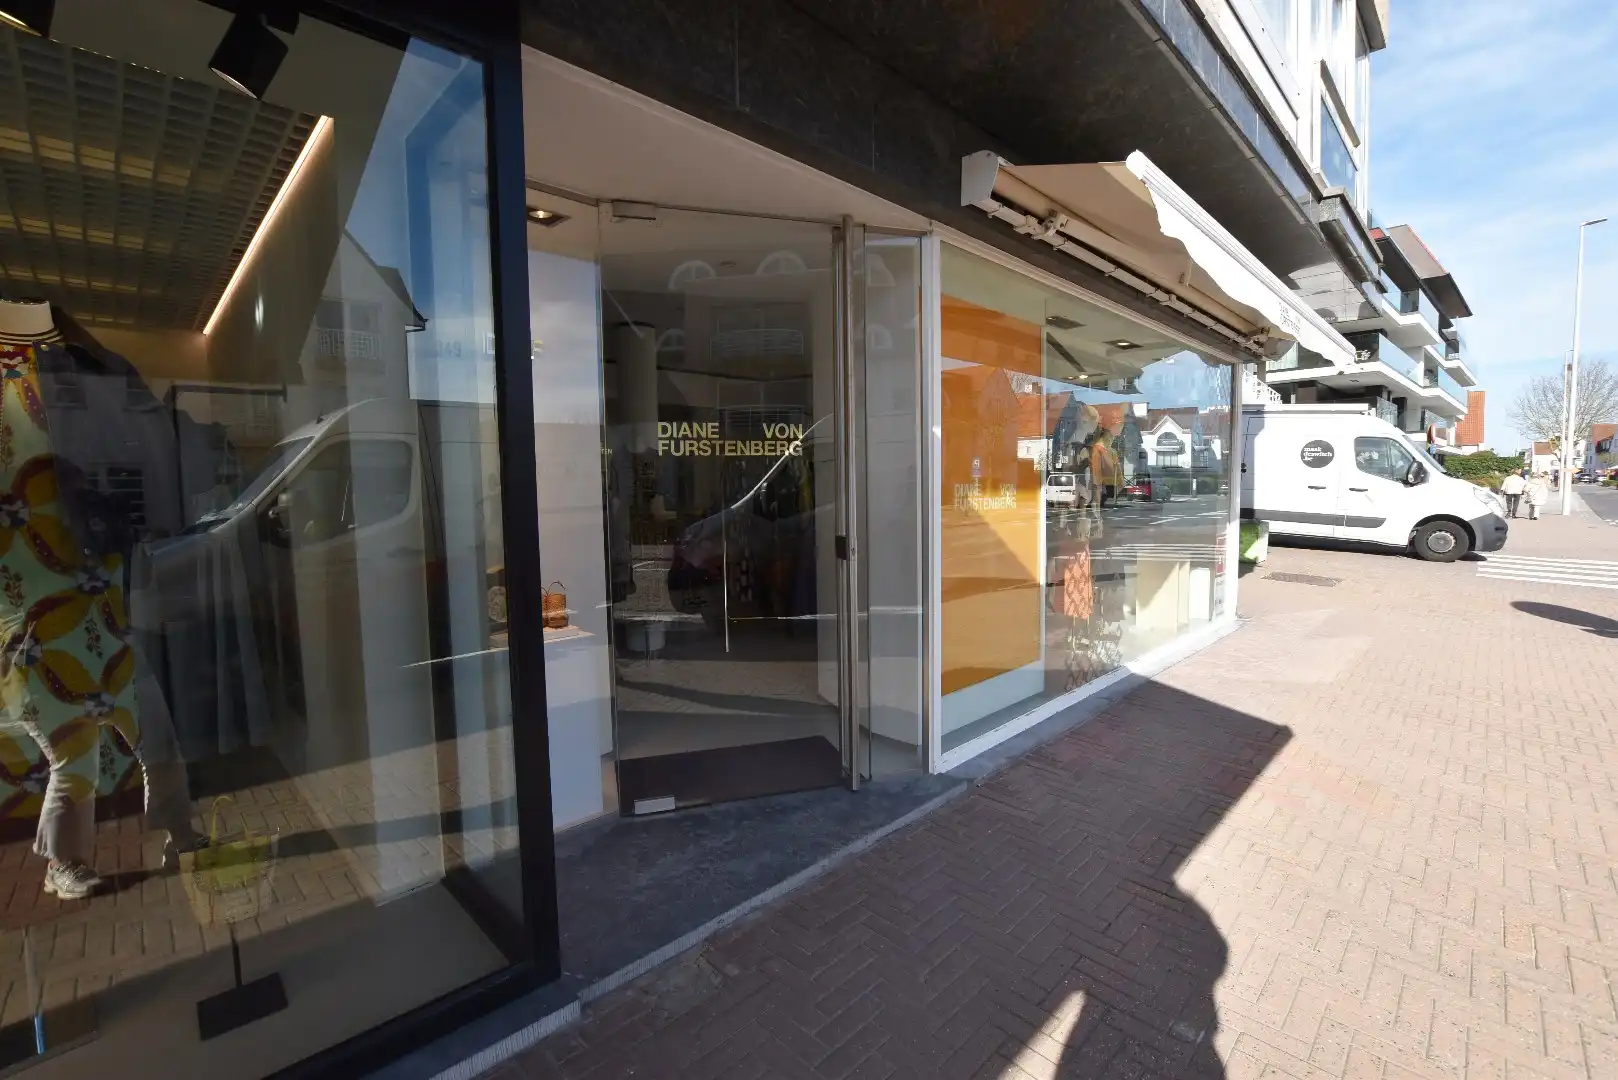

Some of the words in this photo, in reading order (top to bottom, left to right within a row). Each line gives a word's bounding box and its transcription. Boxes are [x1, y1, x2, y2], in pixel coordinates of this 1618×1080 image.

[657, 421, 719, 439] DIANE
[762, 422, 803, 439] VON
[658, 440, 803, 457] FURSTENBERG
